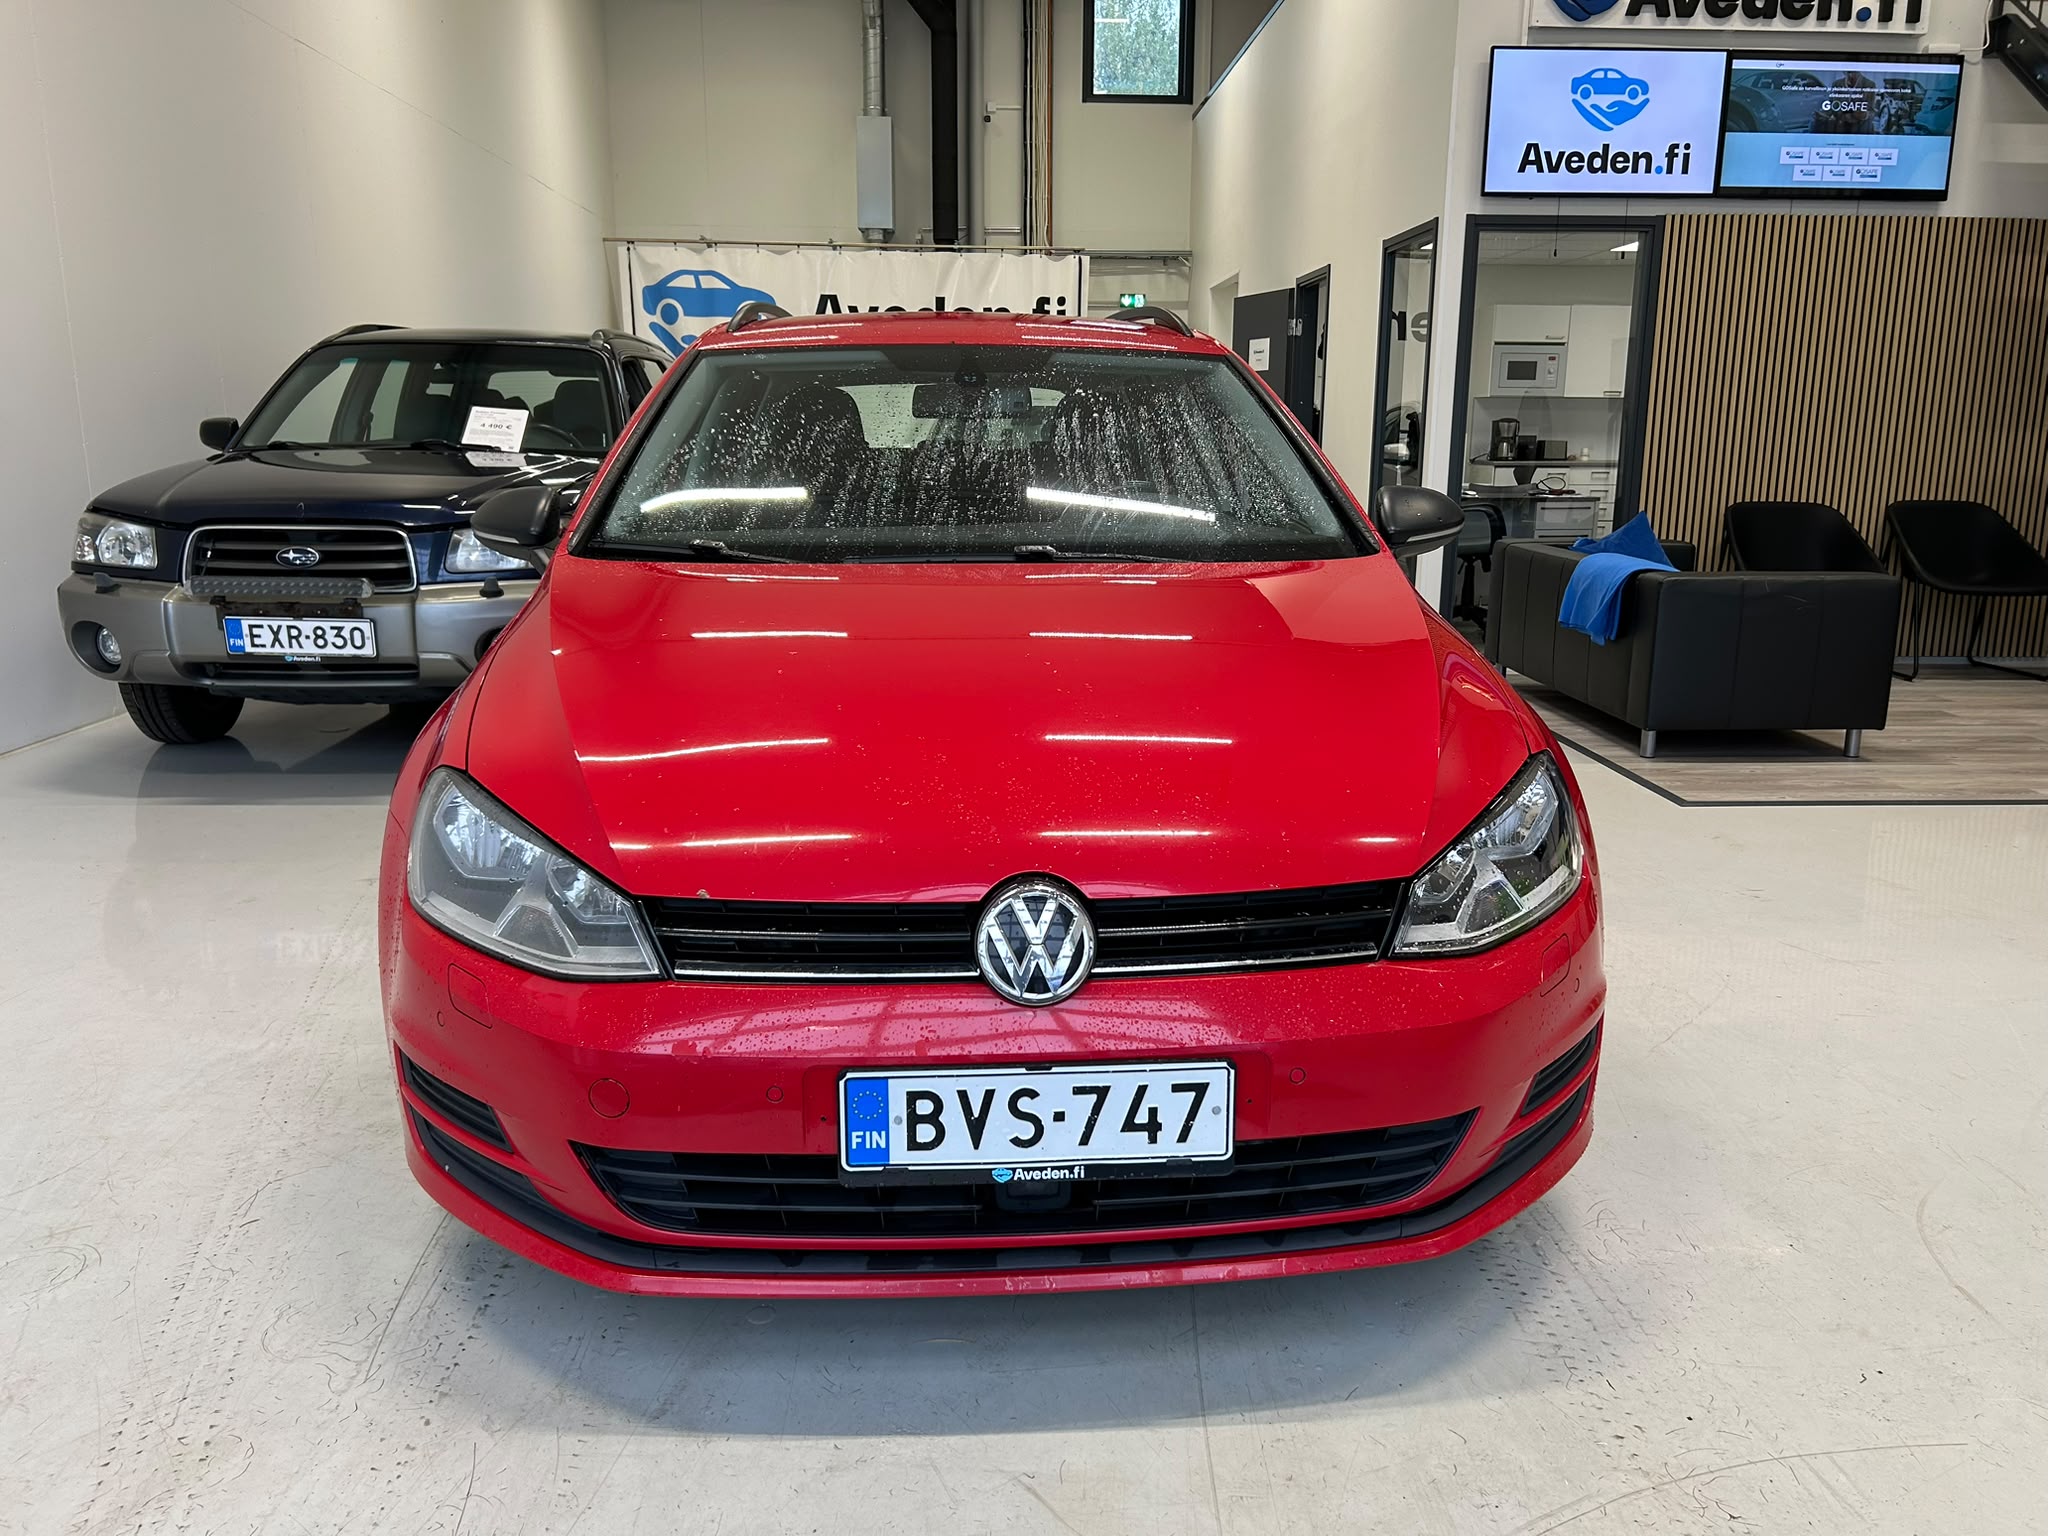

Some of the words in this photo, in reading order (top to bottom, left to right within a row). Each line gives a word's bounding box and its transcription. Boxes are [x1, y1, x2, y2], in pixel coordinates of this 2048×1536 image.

[1822, 101, 1868, 112] GOSAFE
[1517, 142, 1691, 175] Aveden.fi
[229, 638, 244, 646] FIN
[248, 624, 366, 650] EXR-830
[851, 1130, 887, 1150] FIN
[905, 1081, 1210, 1152] BVS-747
[1013, 1166, 1085, 1182] Aveden.fi
